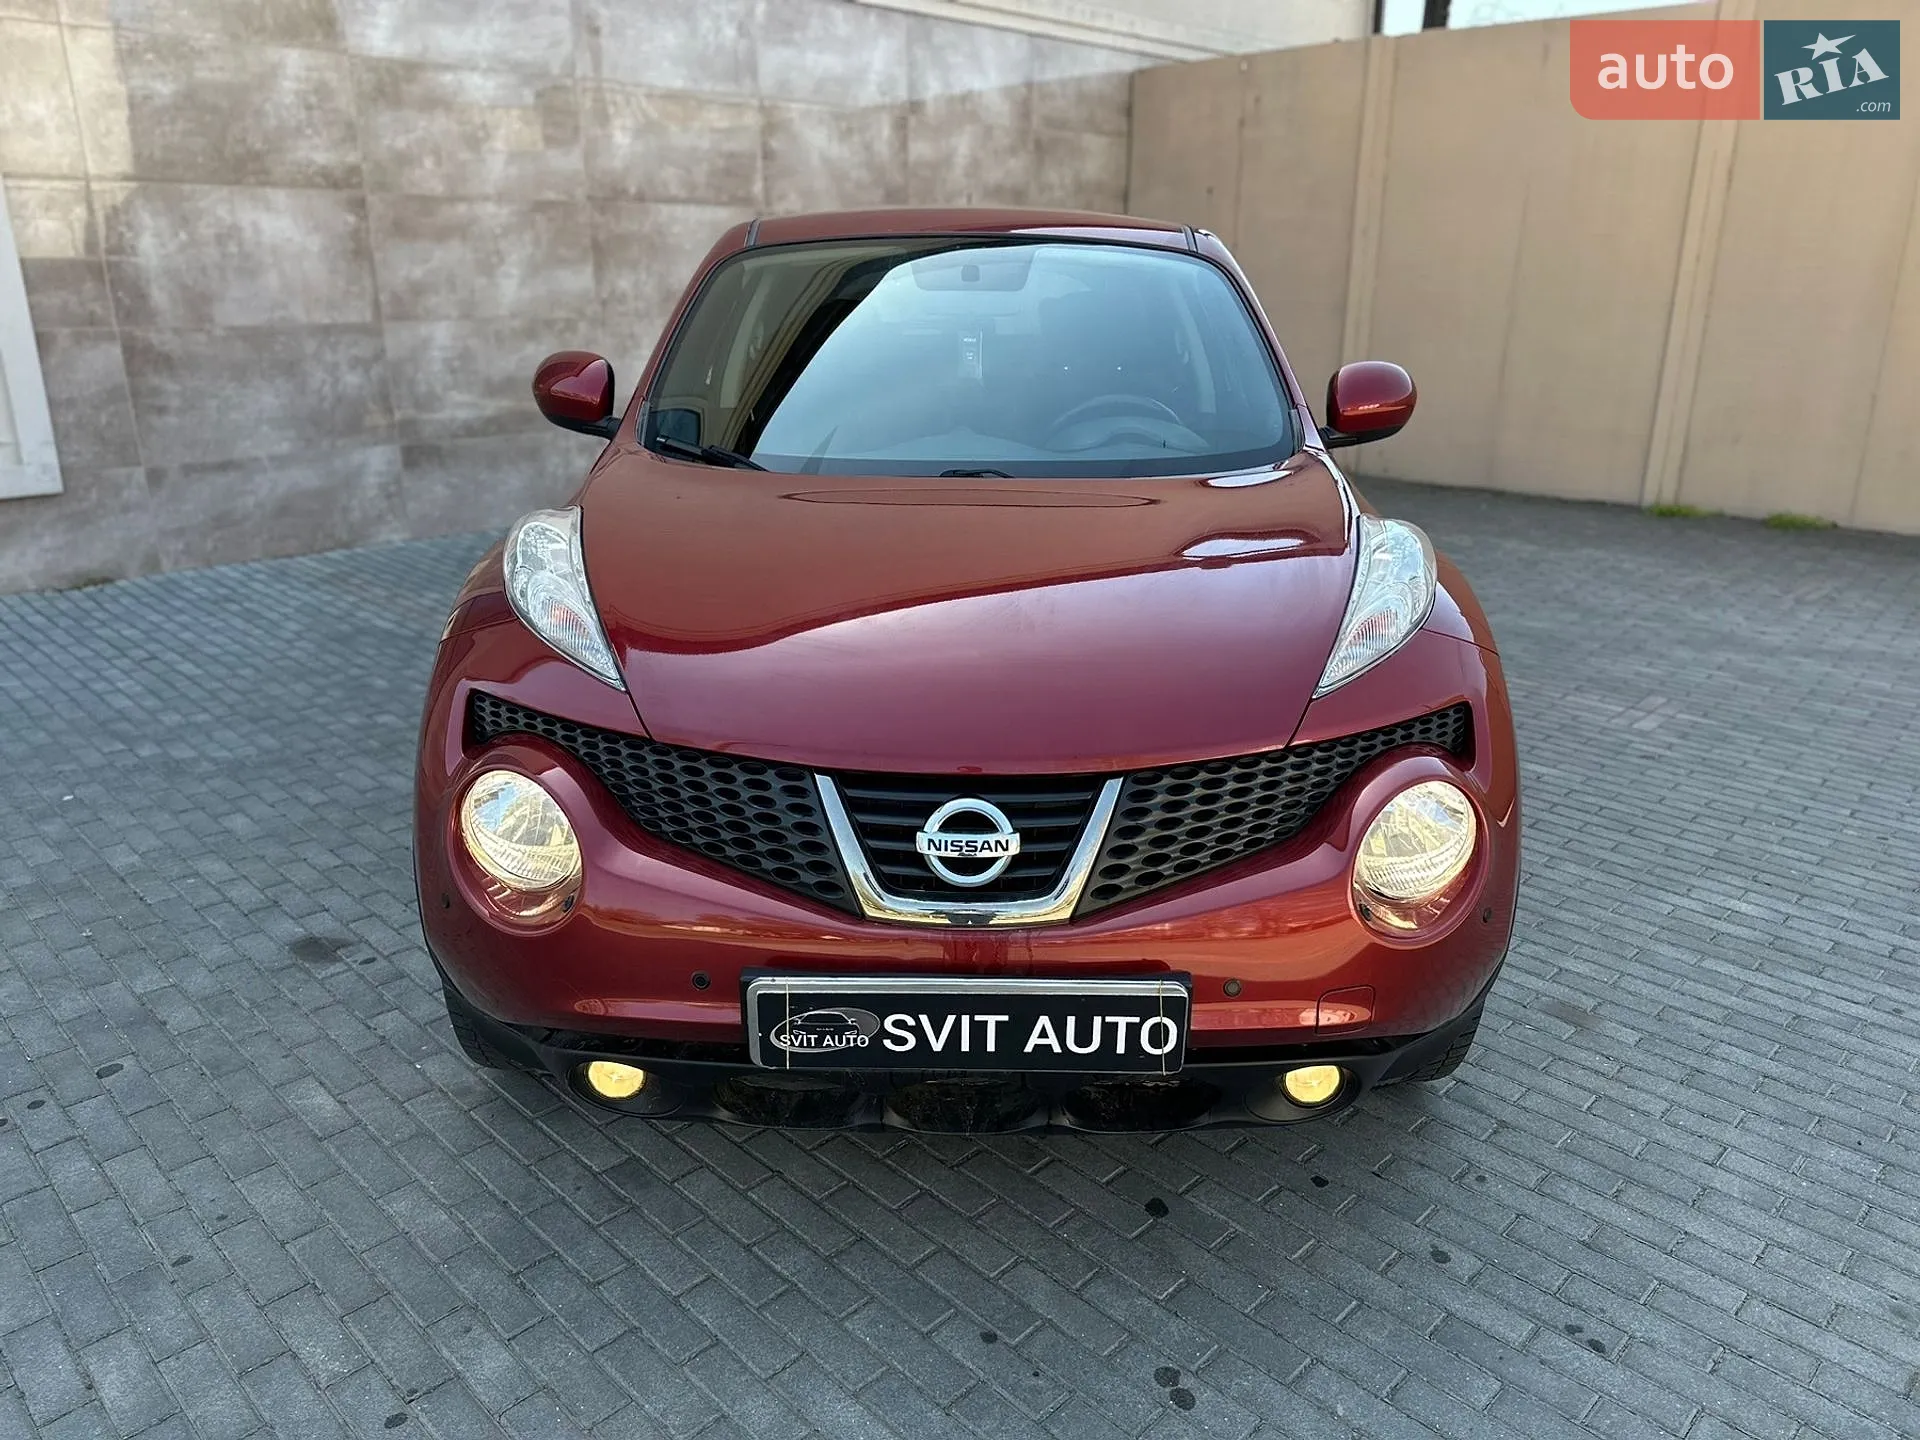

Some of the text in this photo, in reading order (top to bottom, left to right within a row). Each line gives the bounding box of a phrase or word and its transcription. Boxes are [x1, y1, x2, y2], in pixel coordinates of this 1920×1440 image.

[927, 838, 1009, 853] NISSAN
[779, 1034, 869, 1049] SVIT AUTO
[882, 1014, 1178, 1055] SVIT AUTO
